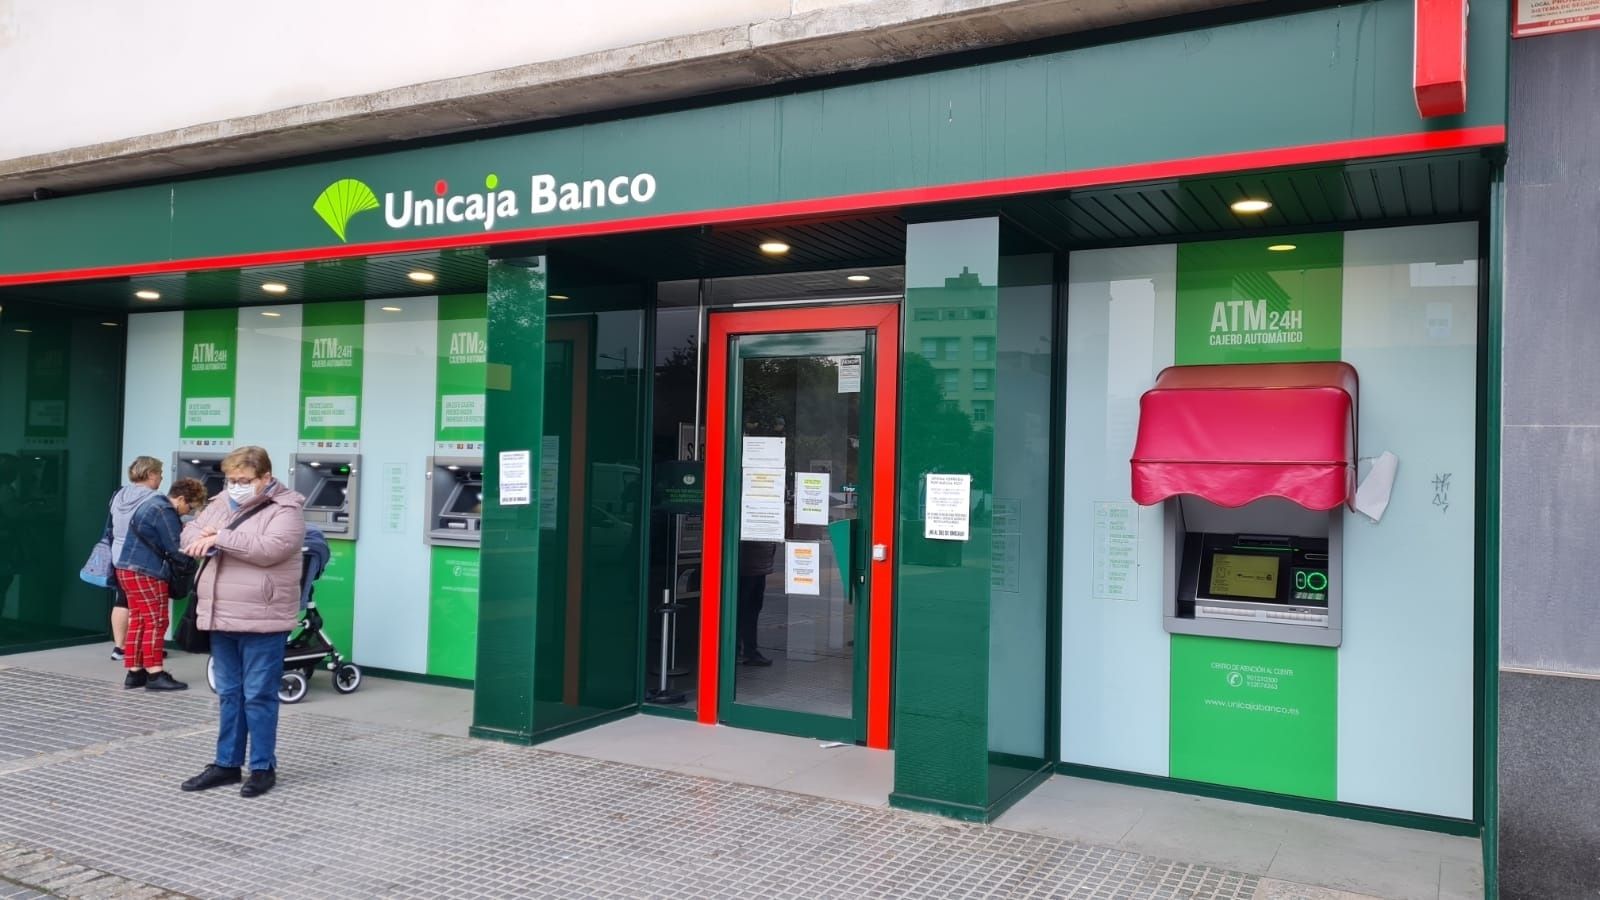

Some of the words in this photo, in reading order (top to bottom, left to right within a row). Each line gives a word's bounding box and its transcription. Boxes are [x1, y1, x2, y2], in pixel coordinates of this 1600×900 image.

[385, 174, 518, 231] Unicaja
[531, 173, 657, 214] Banco
[1210, 299, 1267, 332] ATM
[1269, 310, 1302, 330] 24H
[312, 337, 337, 359] ATM
[337, 345, 353, 358] 24H
[450, 332, 478, 354] ATM
[1209, 334, 1242, 346] CAJERO
[1244, 330, 1303, 345] AUTOMÁTICO
[192, 343, 215, 363] ATM
[215, 349, 228, 362] 24H
[1204, 699, 1300, 715] www.unicajabanco.es
